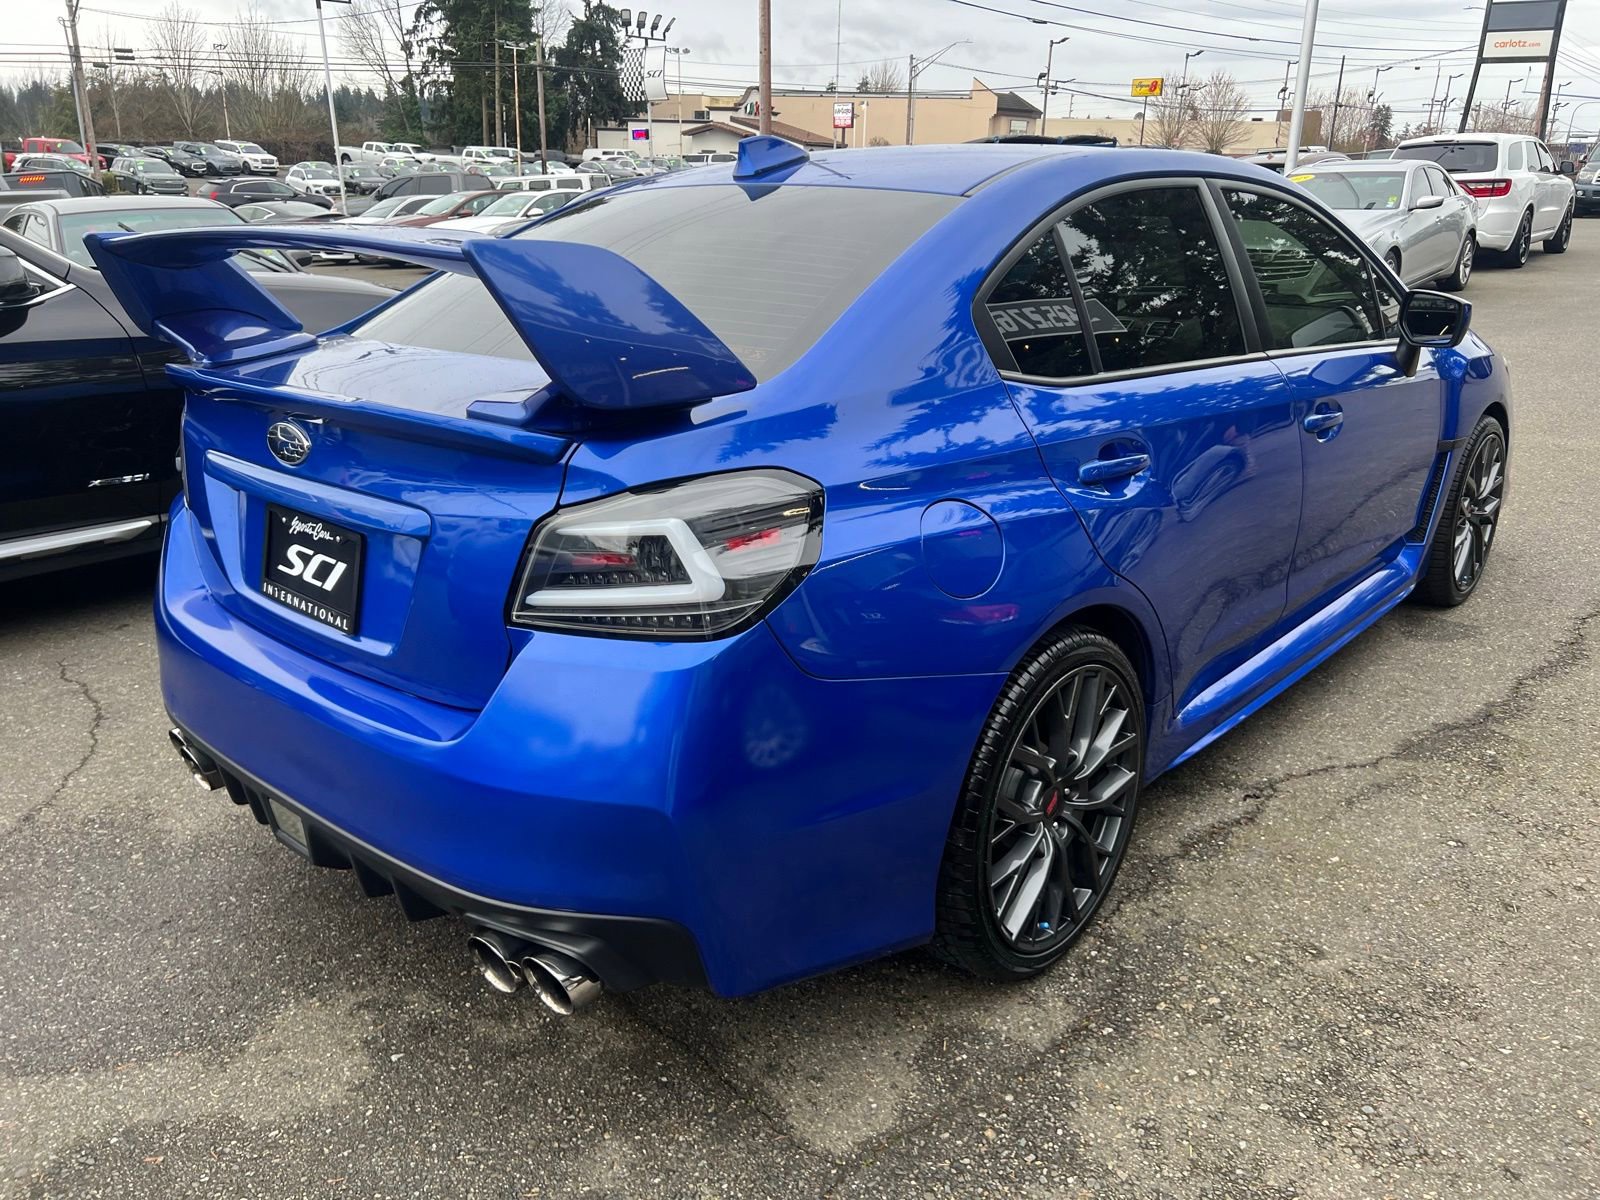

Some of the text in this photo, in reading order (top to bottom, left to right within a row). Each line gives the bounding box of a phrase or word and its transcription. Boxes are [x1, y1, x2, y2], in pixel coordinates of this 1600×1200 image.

[1494, 39, 1541, 48] carlotz.com
[645, 69, 663, 79] SCI
[1148, 80, 1158, 92] 8
[290, 516, 334, 541] Sports Cars
[277, 543, 348, 592] SCI
[263, 582, 349, 631] INTERNATIONAL
